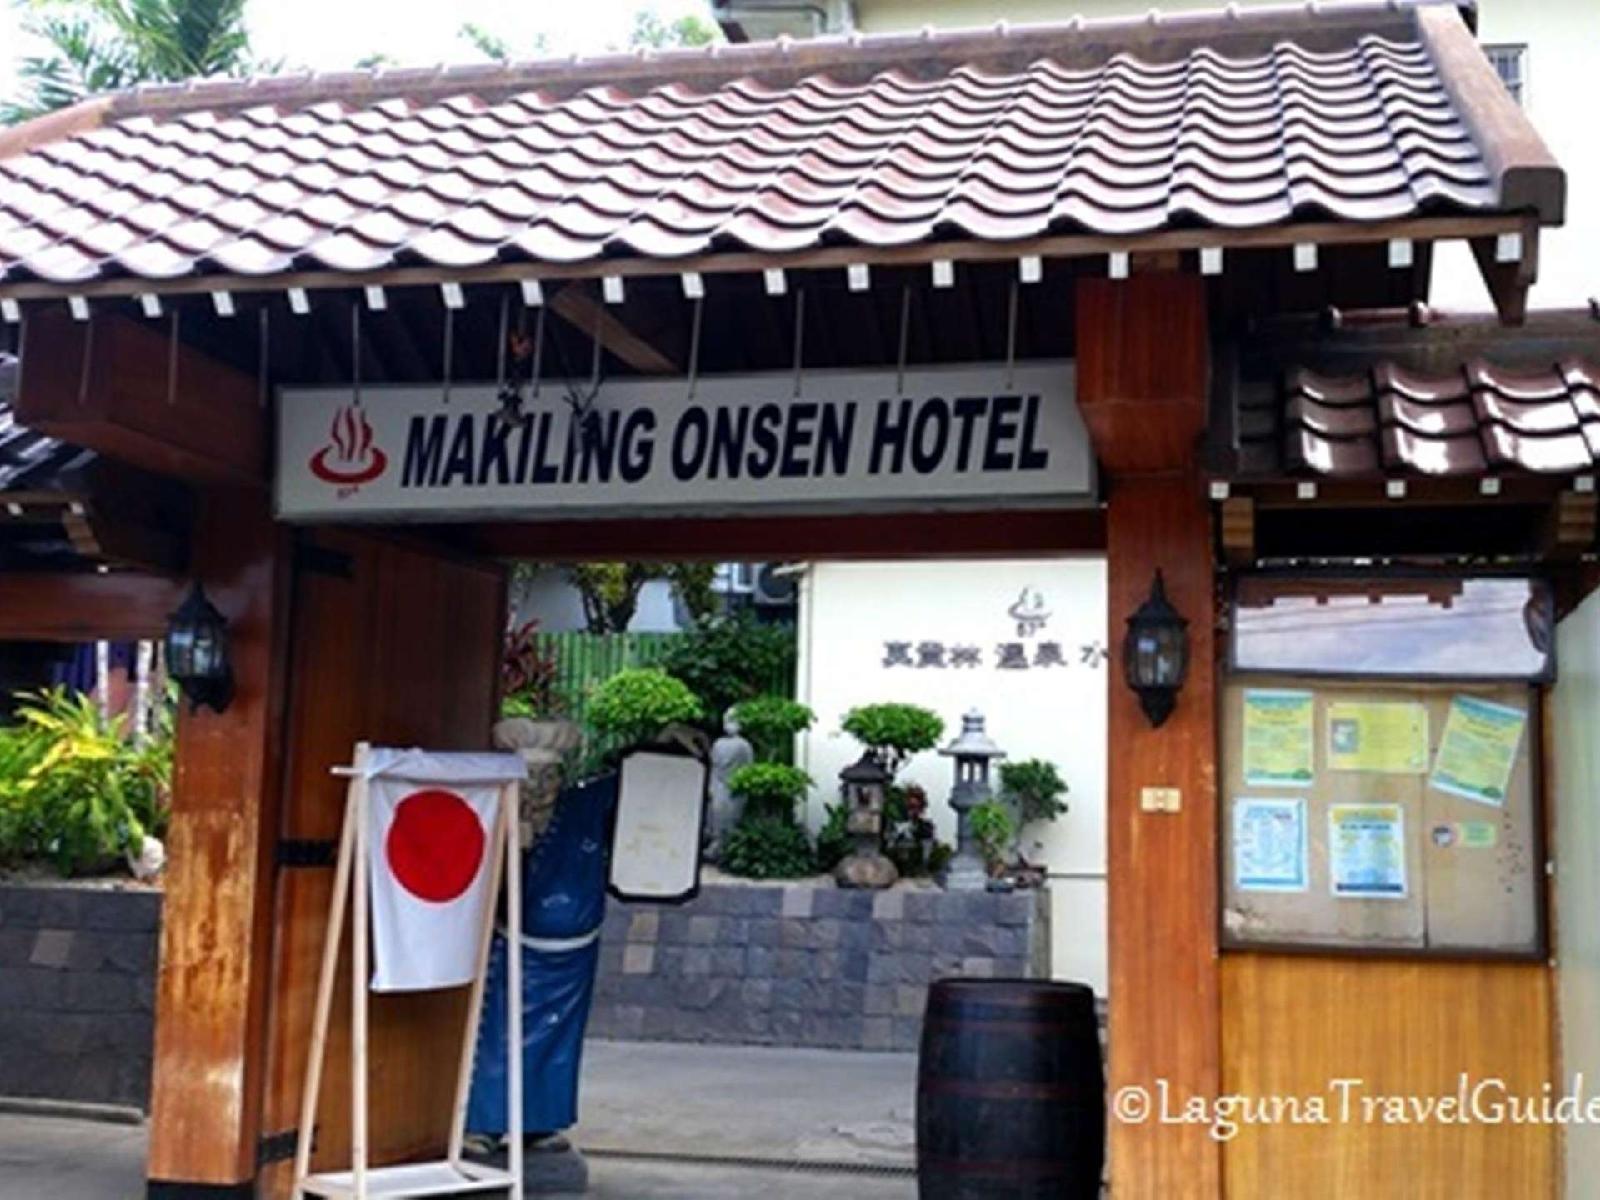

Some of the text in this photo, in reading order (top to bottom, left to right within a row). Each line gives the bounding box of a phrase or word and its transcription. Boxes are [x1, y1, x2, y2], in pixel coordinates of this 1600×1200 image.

[401, 394, 1050, 488] MAKILING ONSEN HOTEL
